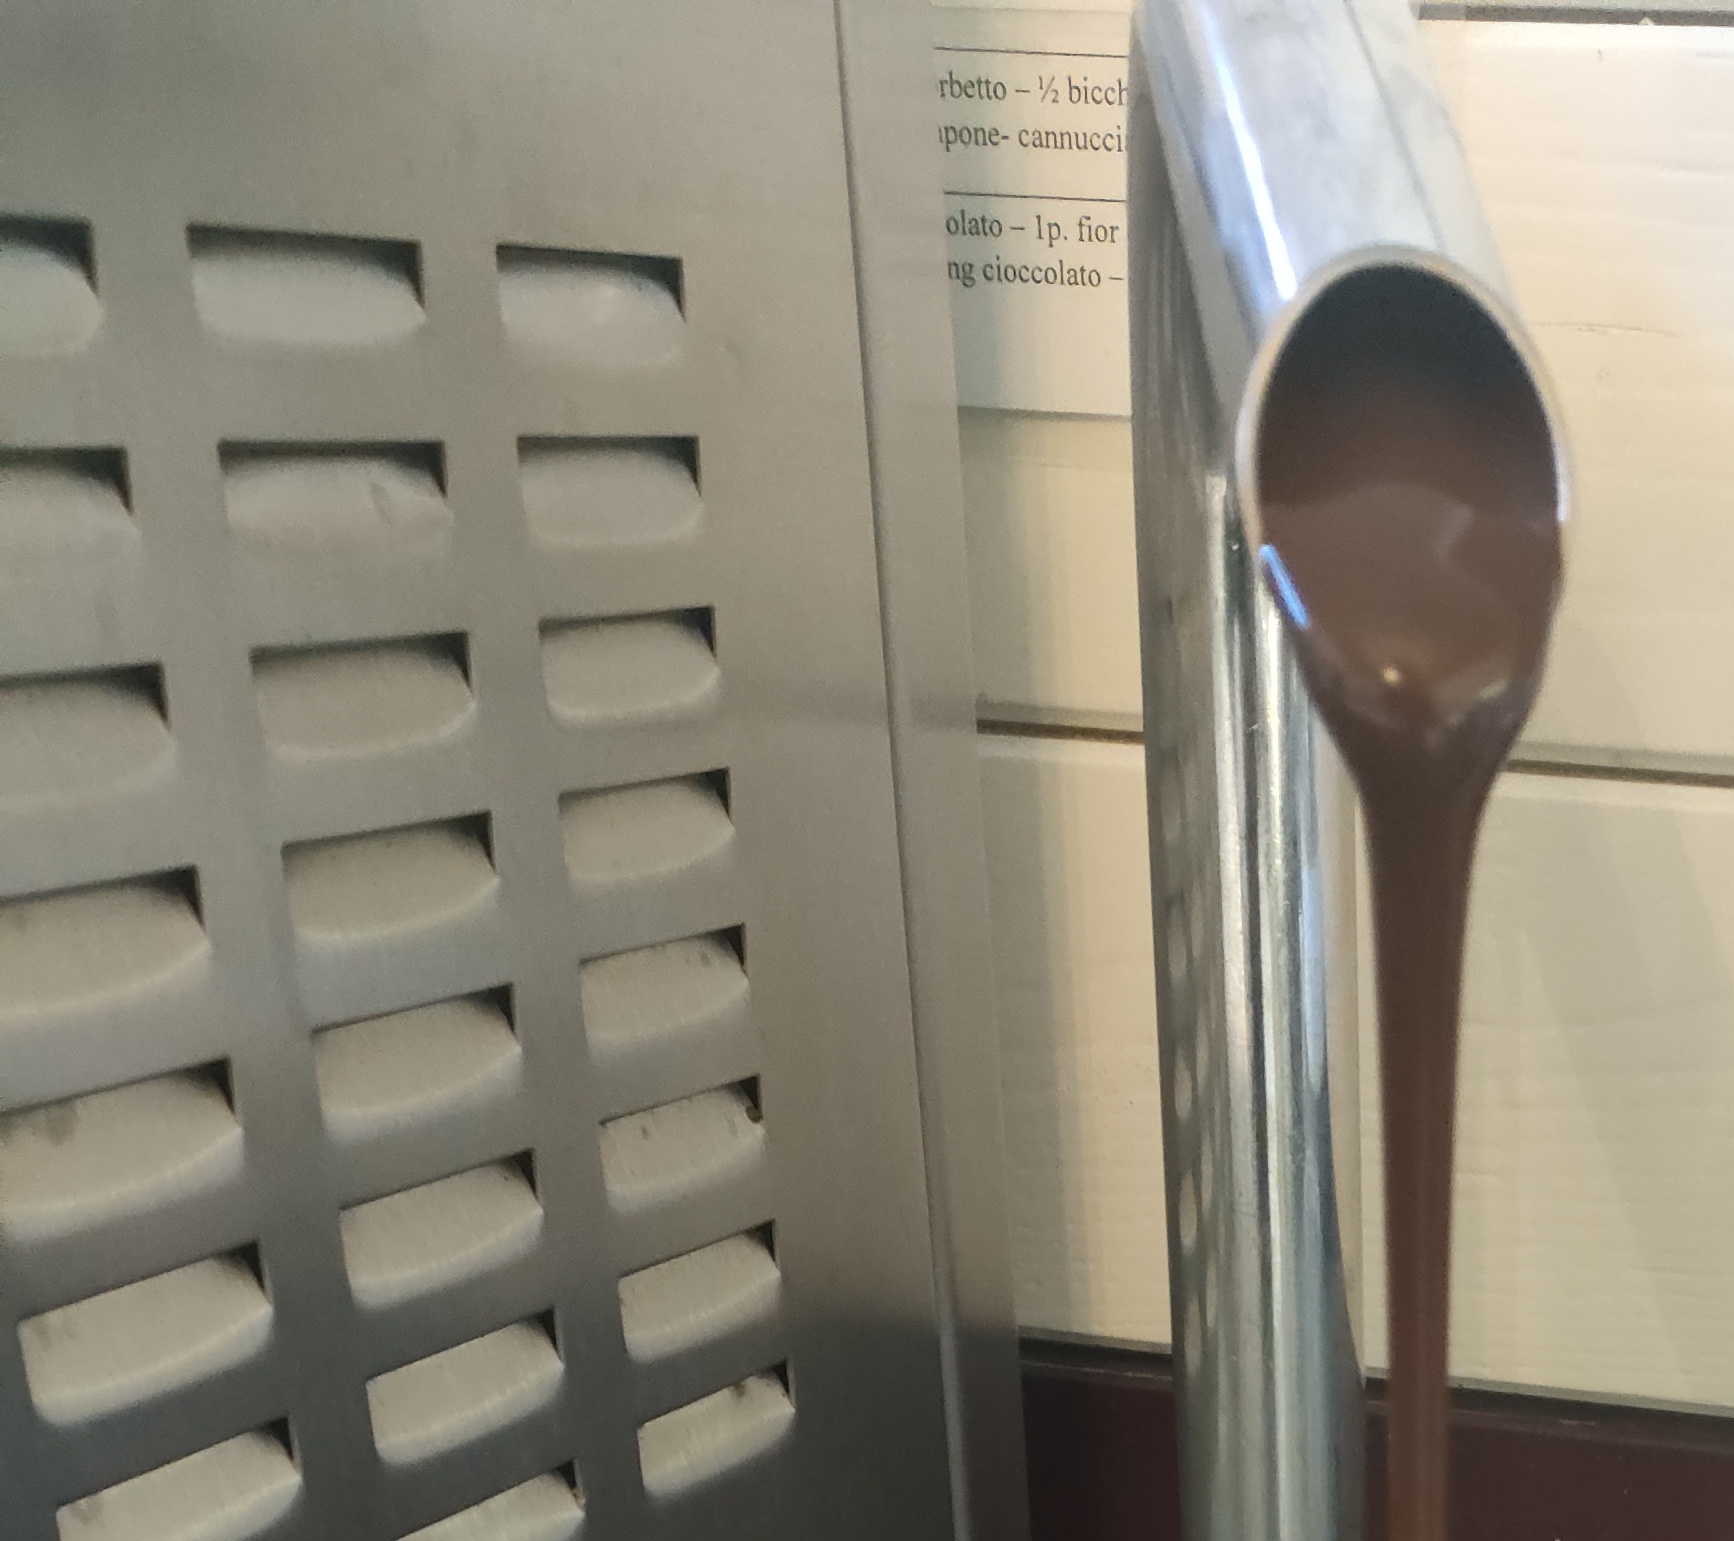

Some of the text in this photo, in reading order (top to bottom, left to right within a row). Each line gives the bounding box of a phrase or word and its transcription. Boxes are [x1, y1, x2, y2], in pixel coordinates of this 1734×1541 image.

[938, 70, 1007, 101] rbetto
[938, 124, 1128, 153] pone- cannucci
[945, 209, 1003, 238] olato
[1078, 216, 1120, 244] fior
[947, 259, 976, 289] ng
[982, 255, 1101, 288] cioccolato
